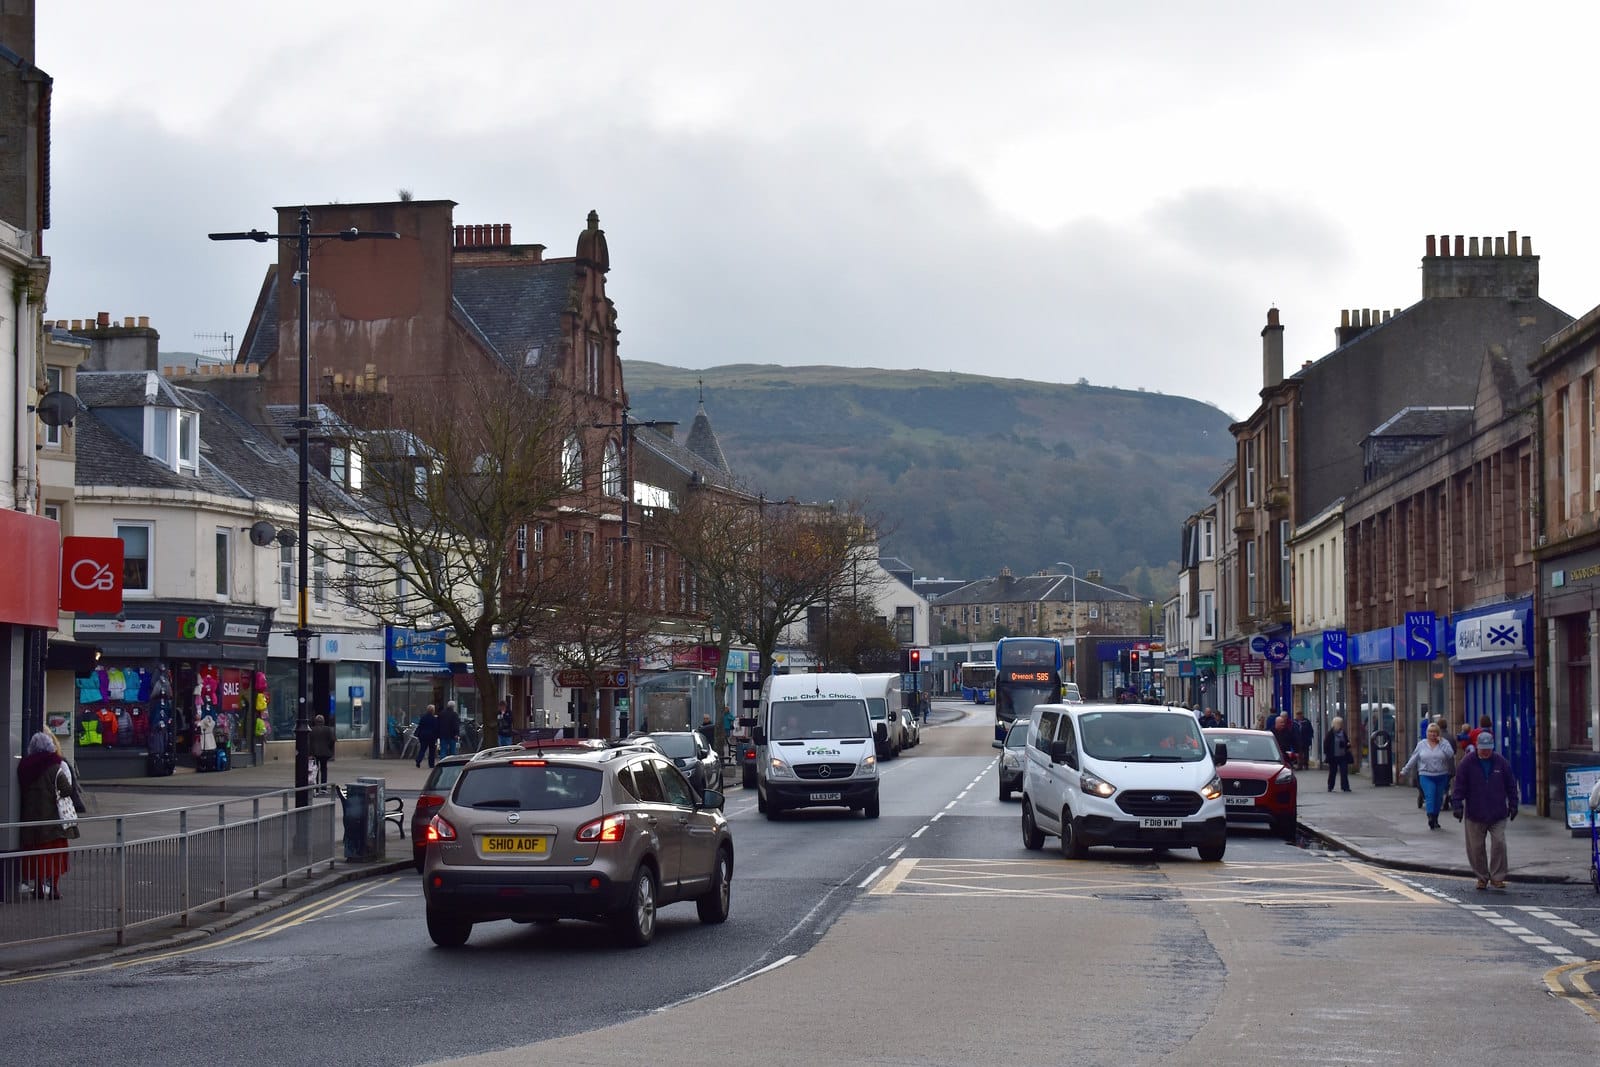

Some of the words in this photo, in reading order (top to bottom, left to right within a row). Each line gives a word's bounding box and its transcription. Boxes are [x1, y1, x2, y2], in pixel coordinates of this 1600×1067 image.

[1409, 616, 1430, 625] WH
[1326, 633, 1342, 642] WH
[1411, 627, 1432, 657] S
[1011, 672, 1034, 681] Greenock
[1036, 672, 1049, 681] 585
[223, 682, 240, 696] SALE
[1144, 818, 1162, 827] FD18
[1163, 818, 1178, 827] WMT
[489, 838, 514, 850] SH10
[516, 838, 540, 850] AOF
